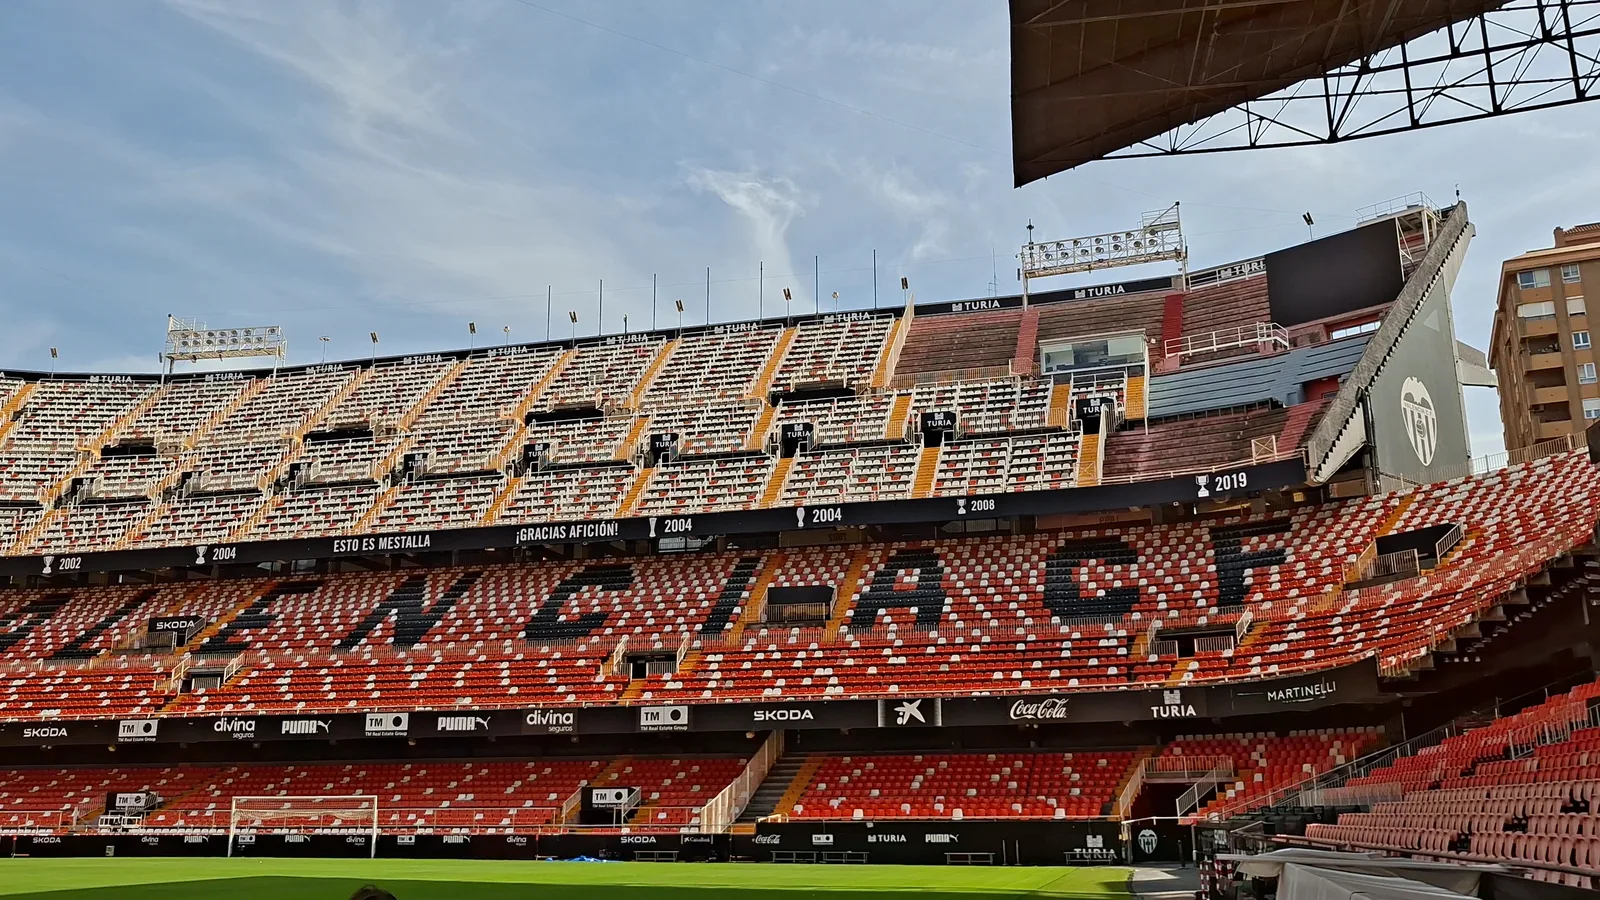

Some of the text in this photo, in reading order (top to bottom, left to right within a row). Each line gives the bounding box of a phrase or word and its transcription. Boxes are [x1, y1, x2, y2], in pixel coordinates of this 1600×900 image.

[1234, 260, 1264, 275] TURI
[1087, 284, 1125, 297] TURIA
[964, 299, 1000, 311] TURIA
[836, 311, 871, 322] TURIA
[725, 322, 759, 333] TURIA
[499, 345, 528, 355] TURIA
[413, 354, 442, 364] TURIA
[101, 375, 133, 384] TURIA
[215, 372, 244, 381] TURIA
[1215, 472, 1248, 492] 2019
[971, 499, 995, 512] 2008
[812, 507, 842, 523] 2004
[664, 518, 693, 533] 2004
[515, 521, 619, 544] ¡GRACIAS AFICIÓN!
[333, 535, 431, 553] ESTO ES MESTALLA
[212, 547, 236, 560] 2004
[59, 557, 81, 570] 2002
[1267, 681, 1336, 701] MARTINELLI
[1010, 698, 1069, 719] Coca-Cola
[1151, 704, 1197, 718] TURIA
[526, 710, 573, 725] divina
[644, 711, 660, 721] TM
[214, 720, 256, 733] divina
[281, 720, 319, 734] PUMA
[369, 718, 383, 727] TM
[437, 716, 477, 731] PUMA
[122, 725, 135, 733] TM
[548, 725, 573, 733] seguros
[118, 796, 129, 804] TM
[594, 793, 607, 801] TM
[184, 835, 203, 843] PUMA
[285, 835, 304, 843] PUMA
[443, 835, 464, 843] PUMA
[506, 836, 527, 844] divina
[878, 834, 907, 842] TURIA
[925, 833, 951, 843] PUMA
[1073, 848, 1118, 860] TURIA
